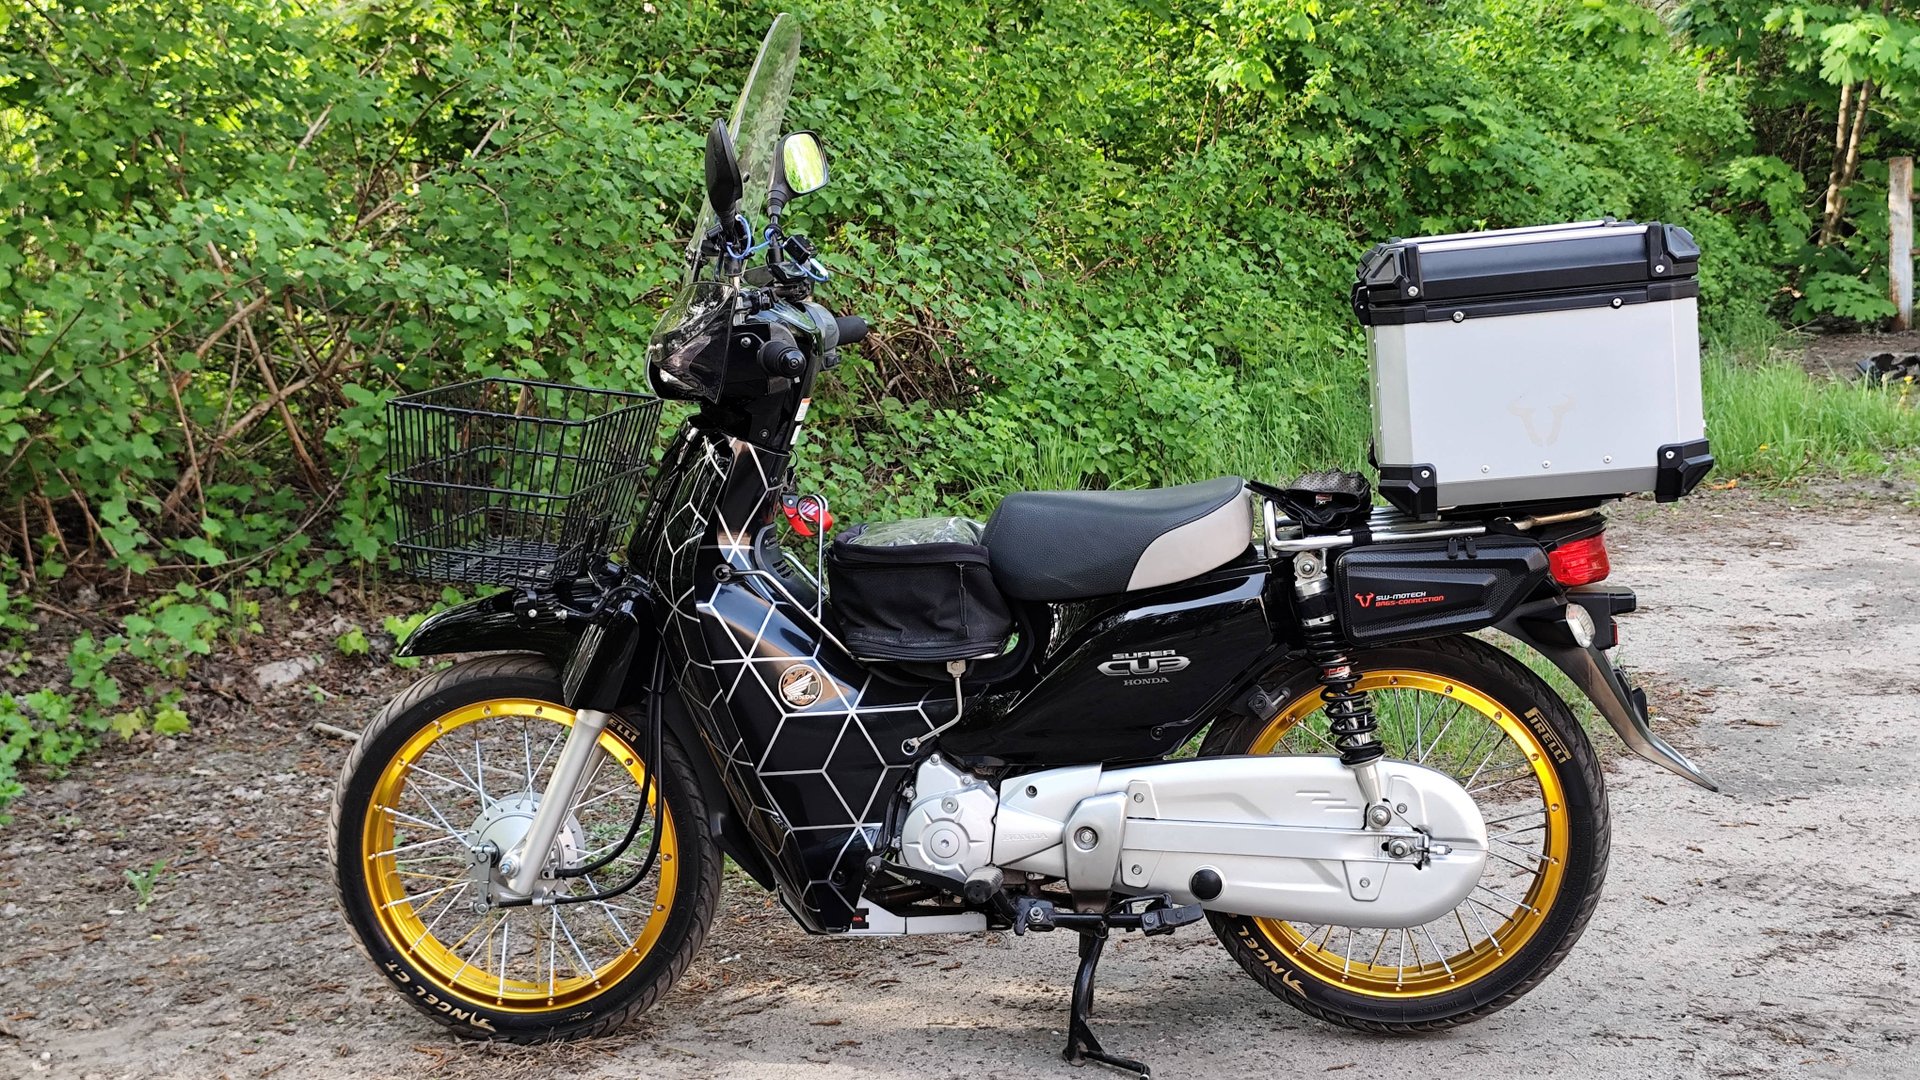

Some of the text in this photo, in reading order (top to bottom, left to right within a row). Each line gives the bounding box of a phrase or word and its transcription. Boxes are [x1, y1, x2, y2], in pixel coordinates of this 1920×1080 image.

[1375, 591, 1427, 601] SW-MOTECH
[1375, 595, 1445, 608] BAGS-CONNECTION
[1112, 649, 1176, 660] SUPER
[1097, 656, 1191, 676] CUB
[1123, 677, 1170, 686] HONDA
[608, 712, 641, 742] ELLI
[1524, 706, 1572, 764] PIRELLI
